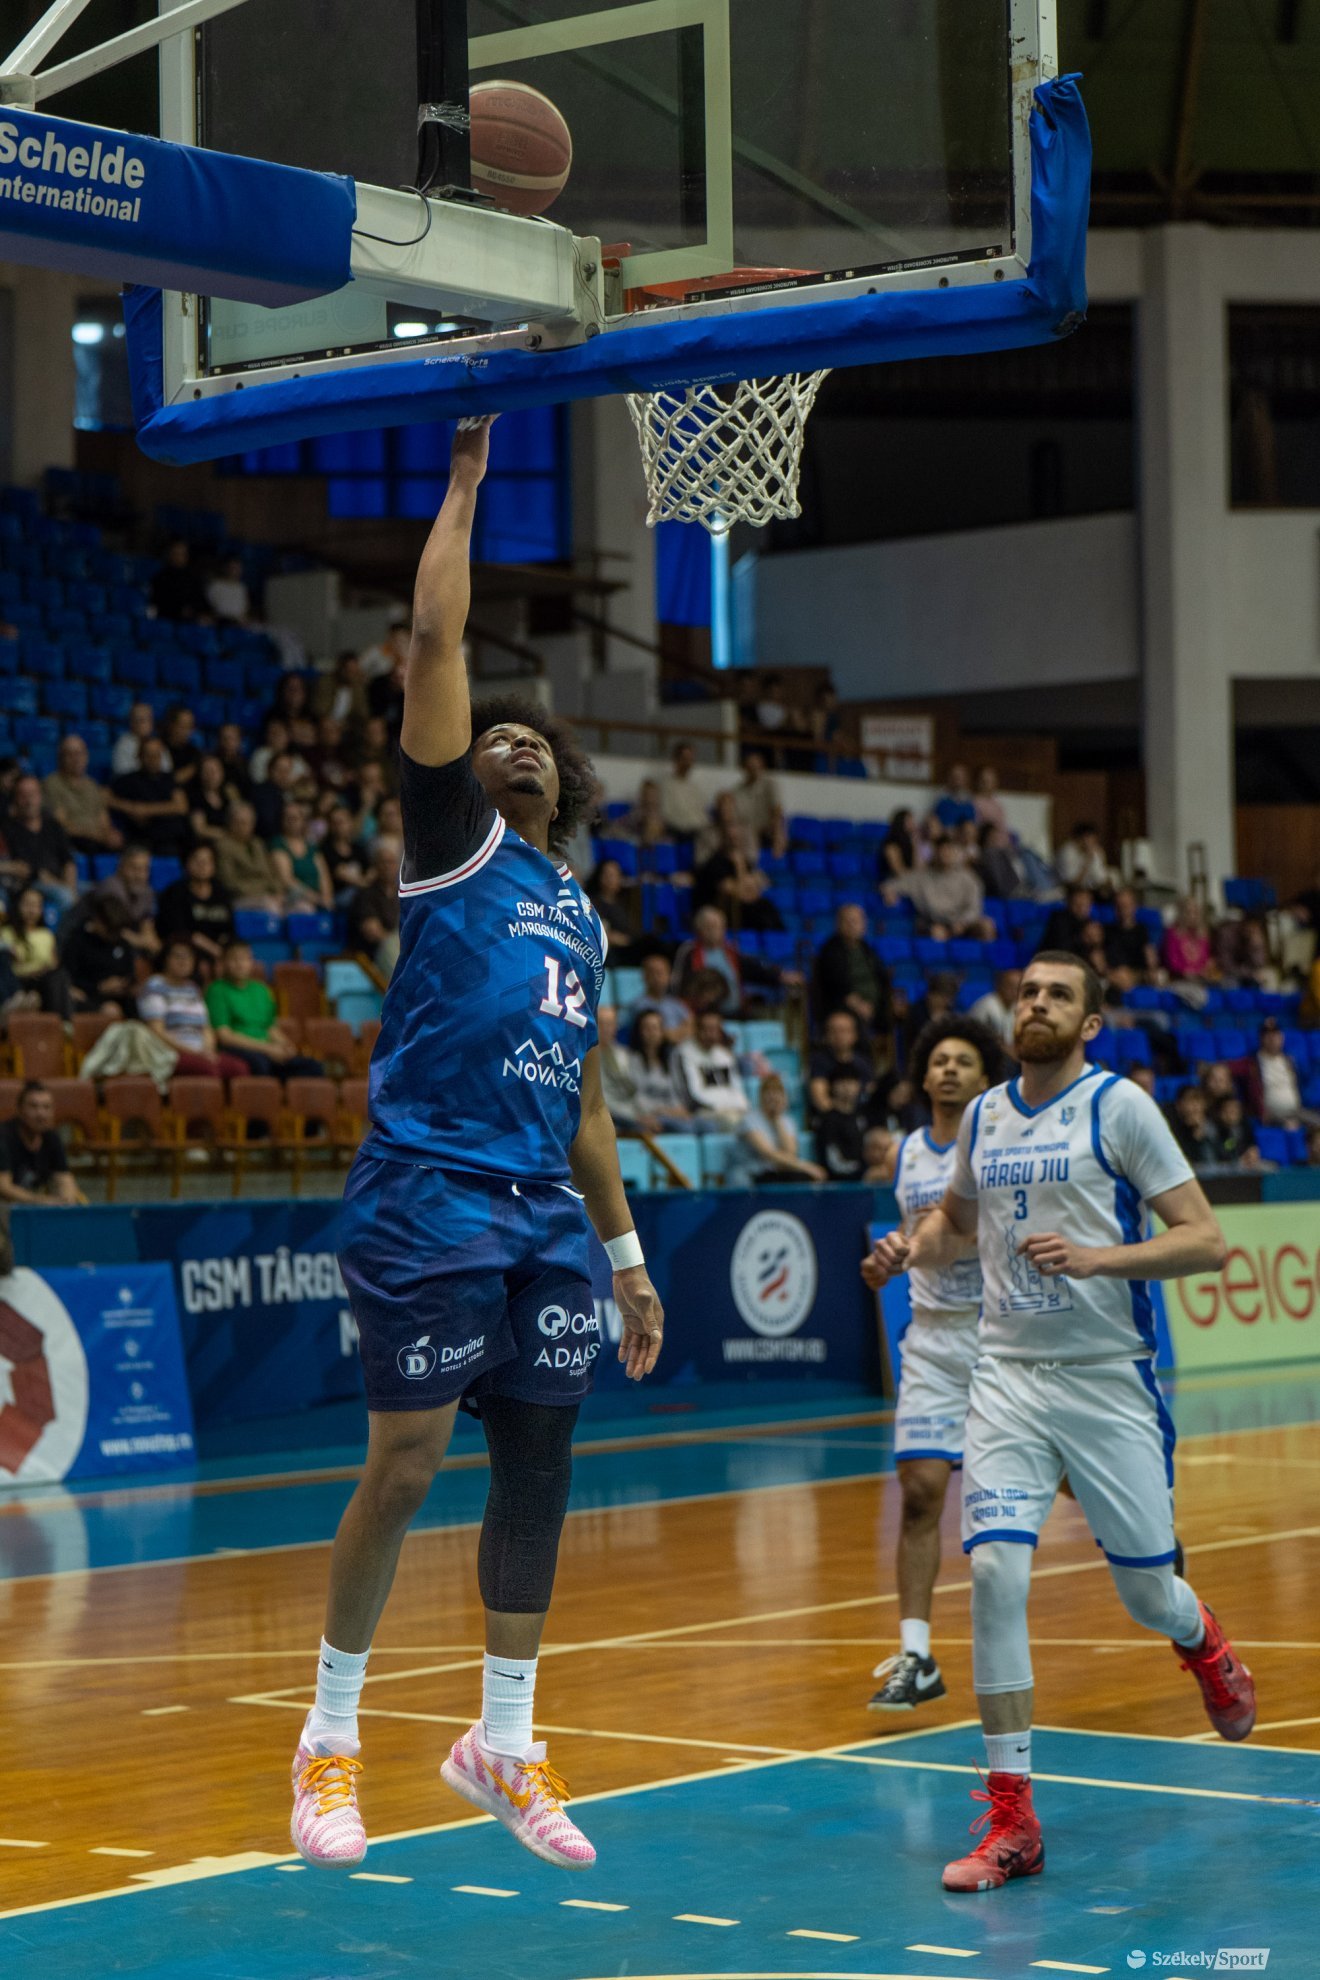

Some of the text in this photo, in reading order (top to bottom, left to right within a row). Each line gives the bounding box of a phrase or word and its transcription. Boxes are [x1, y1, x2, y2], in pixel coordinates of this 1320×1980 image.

[0, 121, 146, 190] Schelde
[0, 173, 142, 222] nternational
[516, 901, 544, 919] CSM
[539, 954, 588, 1029] 12
[1039, 1157, 1069, 1183] JIU
[1014, 1189, 1028, 1221] 3
[181, 1256, 252, 1314] CSM
[406, 1354, 429, 1376] D
[441, 1335, 485, 1364] Darina
